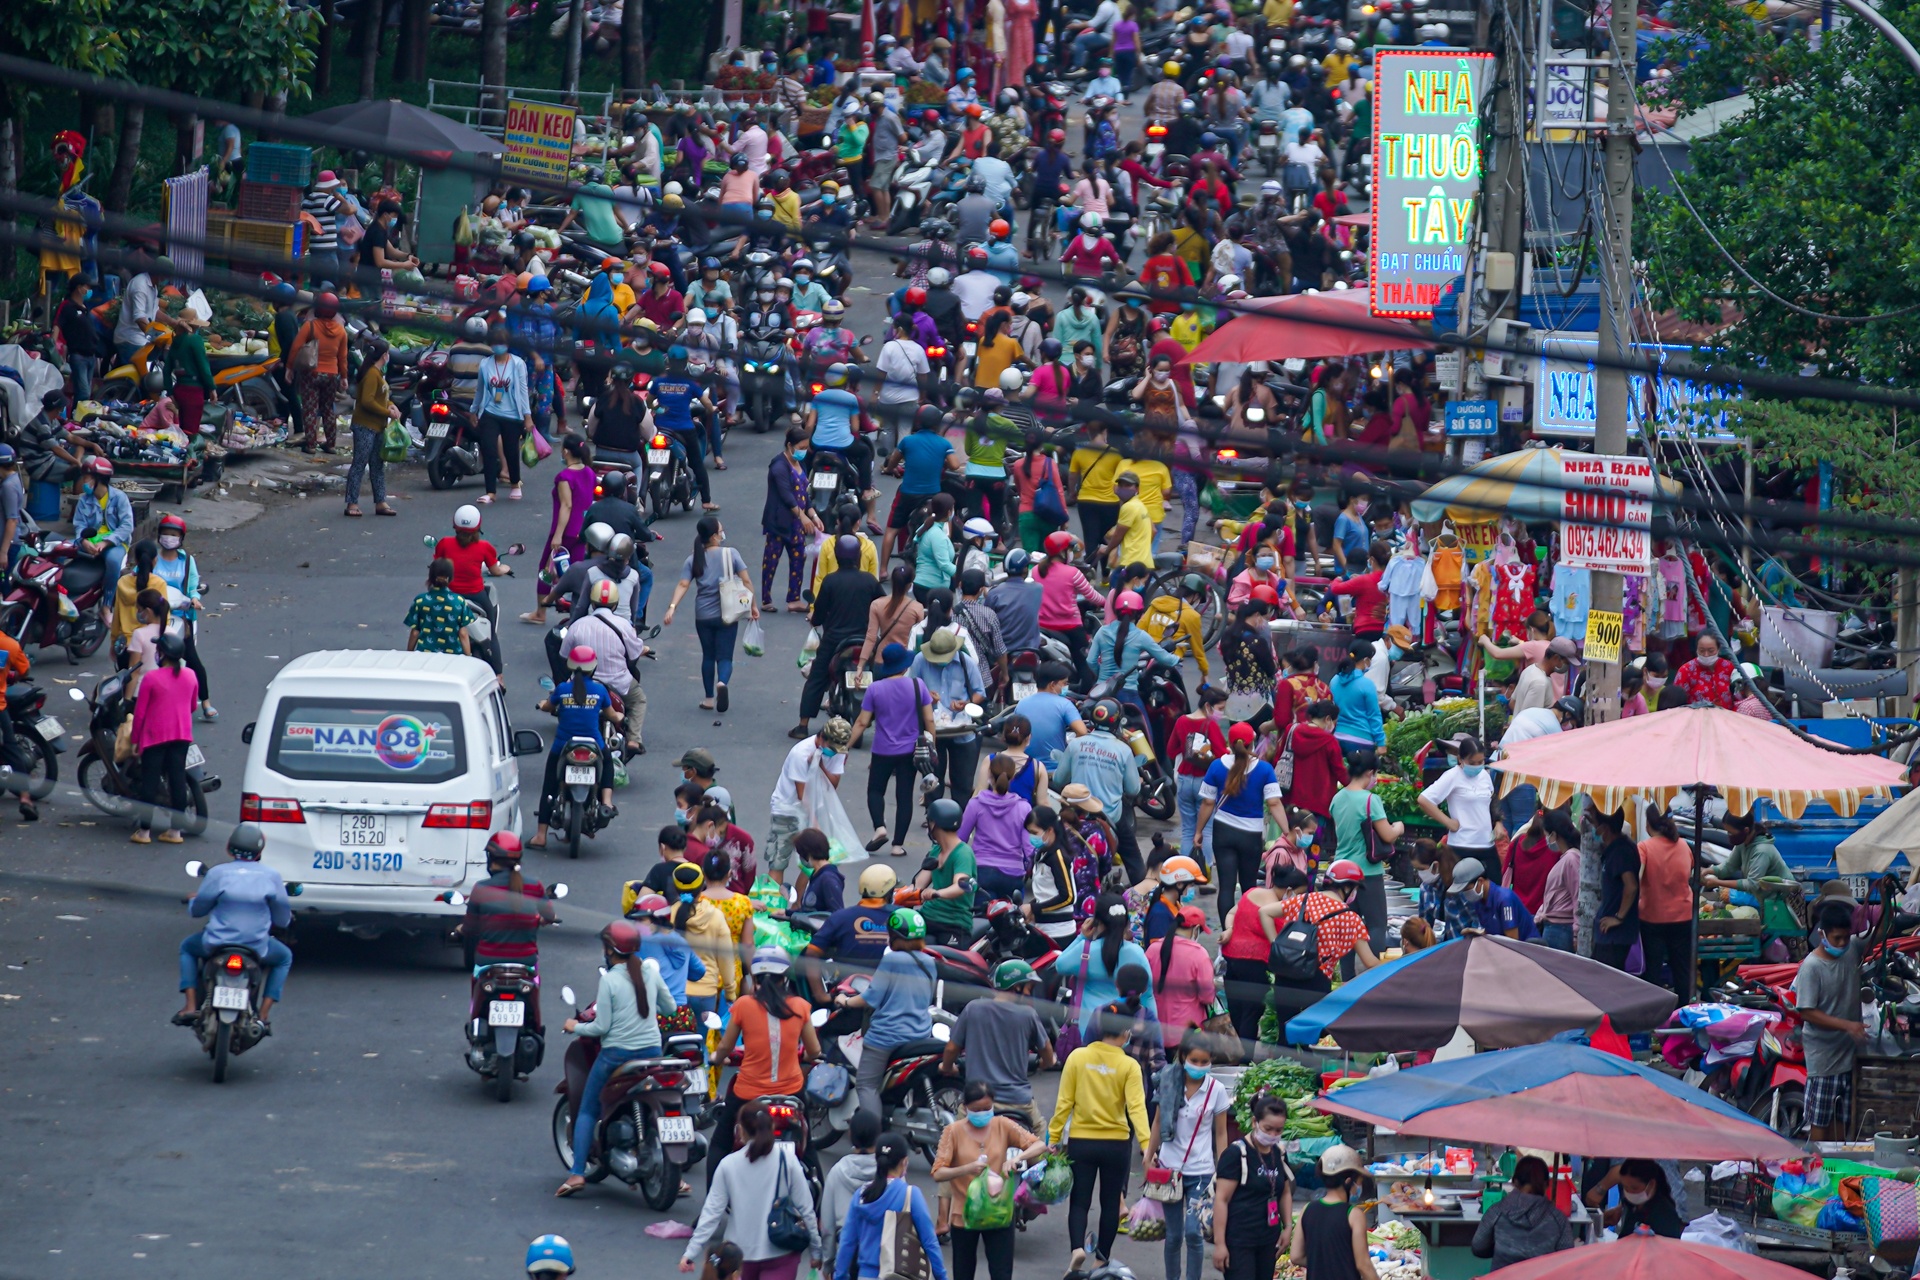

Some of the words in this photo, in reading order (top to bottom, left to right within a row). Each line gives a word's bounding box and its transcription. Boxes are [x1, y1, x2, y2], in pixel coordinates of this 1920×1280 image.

[1405, 59, 1475, 114] NHÀ
[508, 104, 540, 133] DÁN
[543, 113, 573, 139] KEO
[1380, 117, 1484, 180] THUỐ
[1403, 186, 1475, 244] TÂY
[1381, 252, 1409, 274] ĐẠT
[1414, 246, 1462, 272] CHUẨN
[1452, 416, 1465, 430] SỐ
[1468, 418, 1481, 430] 53
[1584, 475, 1607, 487] MỘT
[1610, 475, 1629, 487] LẦU
[1611, 461, 1651, 477] BÁN
[1565, 487, 1626, 525] 900
[1567, 524, 1644, 560] 0975.462.434
[1596, 621, 1621, 646] 900
[289, 727, 314, 735] SƠN
[315, 728, 421, 748] NANO8
[352, 815, 375, 829] 29D
[342, 830, 384, 845] 315.20
[313, 851, 403, 872] 29D-31520
